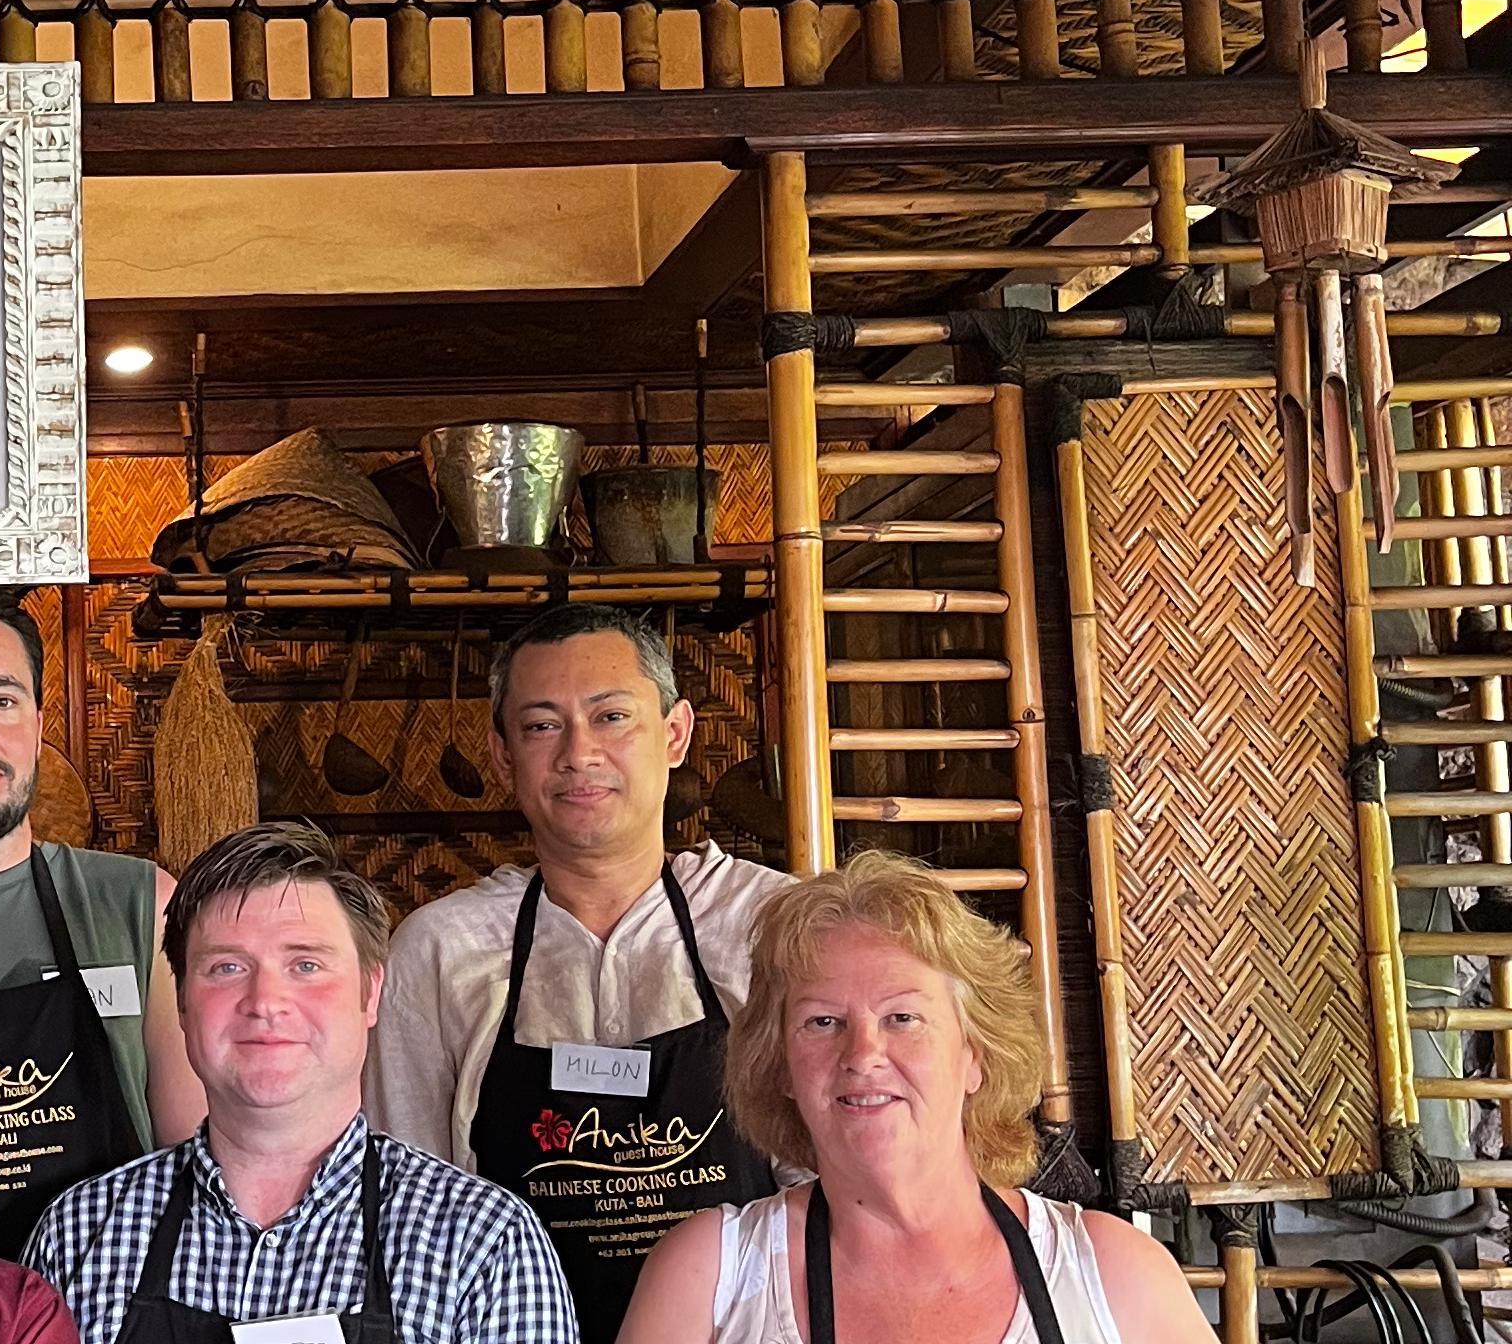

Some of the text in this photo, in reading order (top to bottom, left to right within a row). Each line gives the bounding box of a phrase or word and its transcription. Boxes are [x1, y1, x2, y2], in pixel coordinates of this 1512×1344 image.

[4, 1085, 36, 1099] house
[31, 1106, 76, 1124] CLASS
[569, 1107, 701, 1153] Anika
[614, 1144, 685, 1163] guest house
[529, 1165, 726, 1197] BALINESE COOKING CLASS
